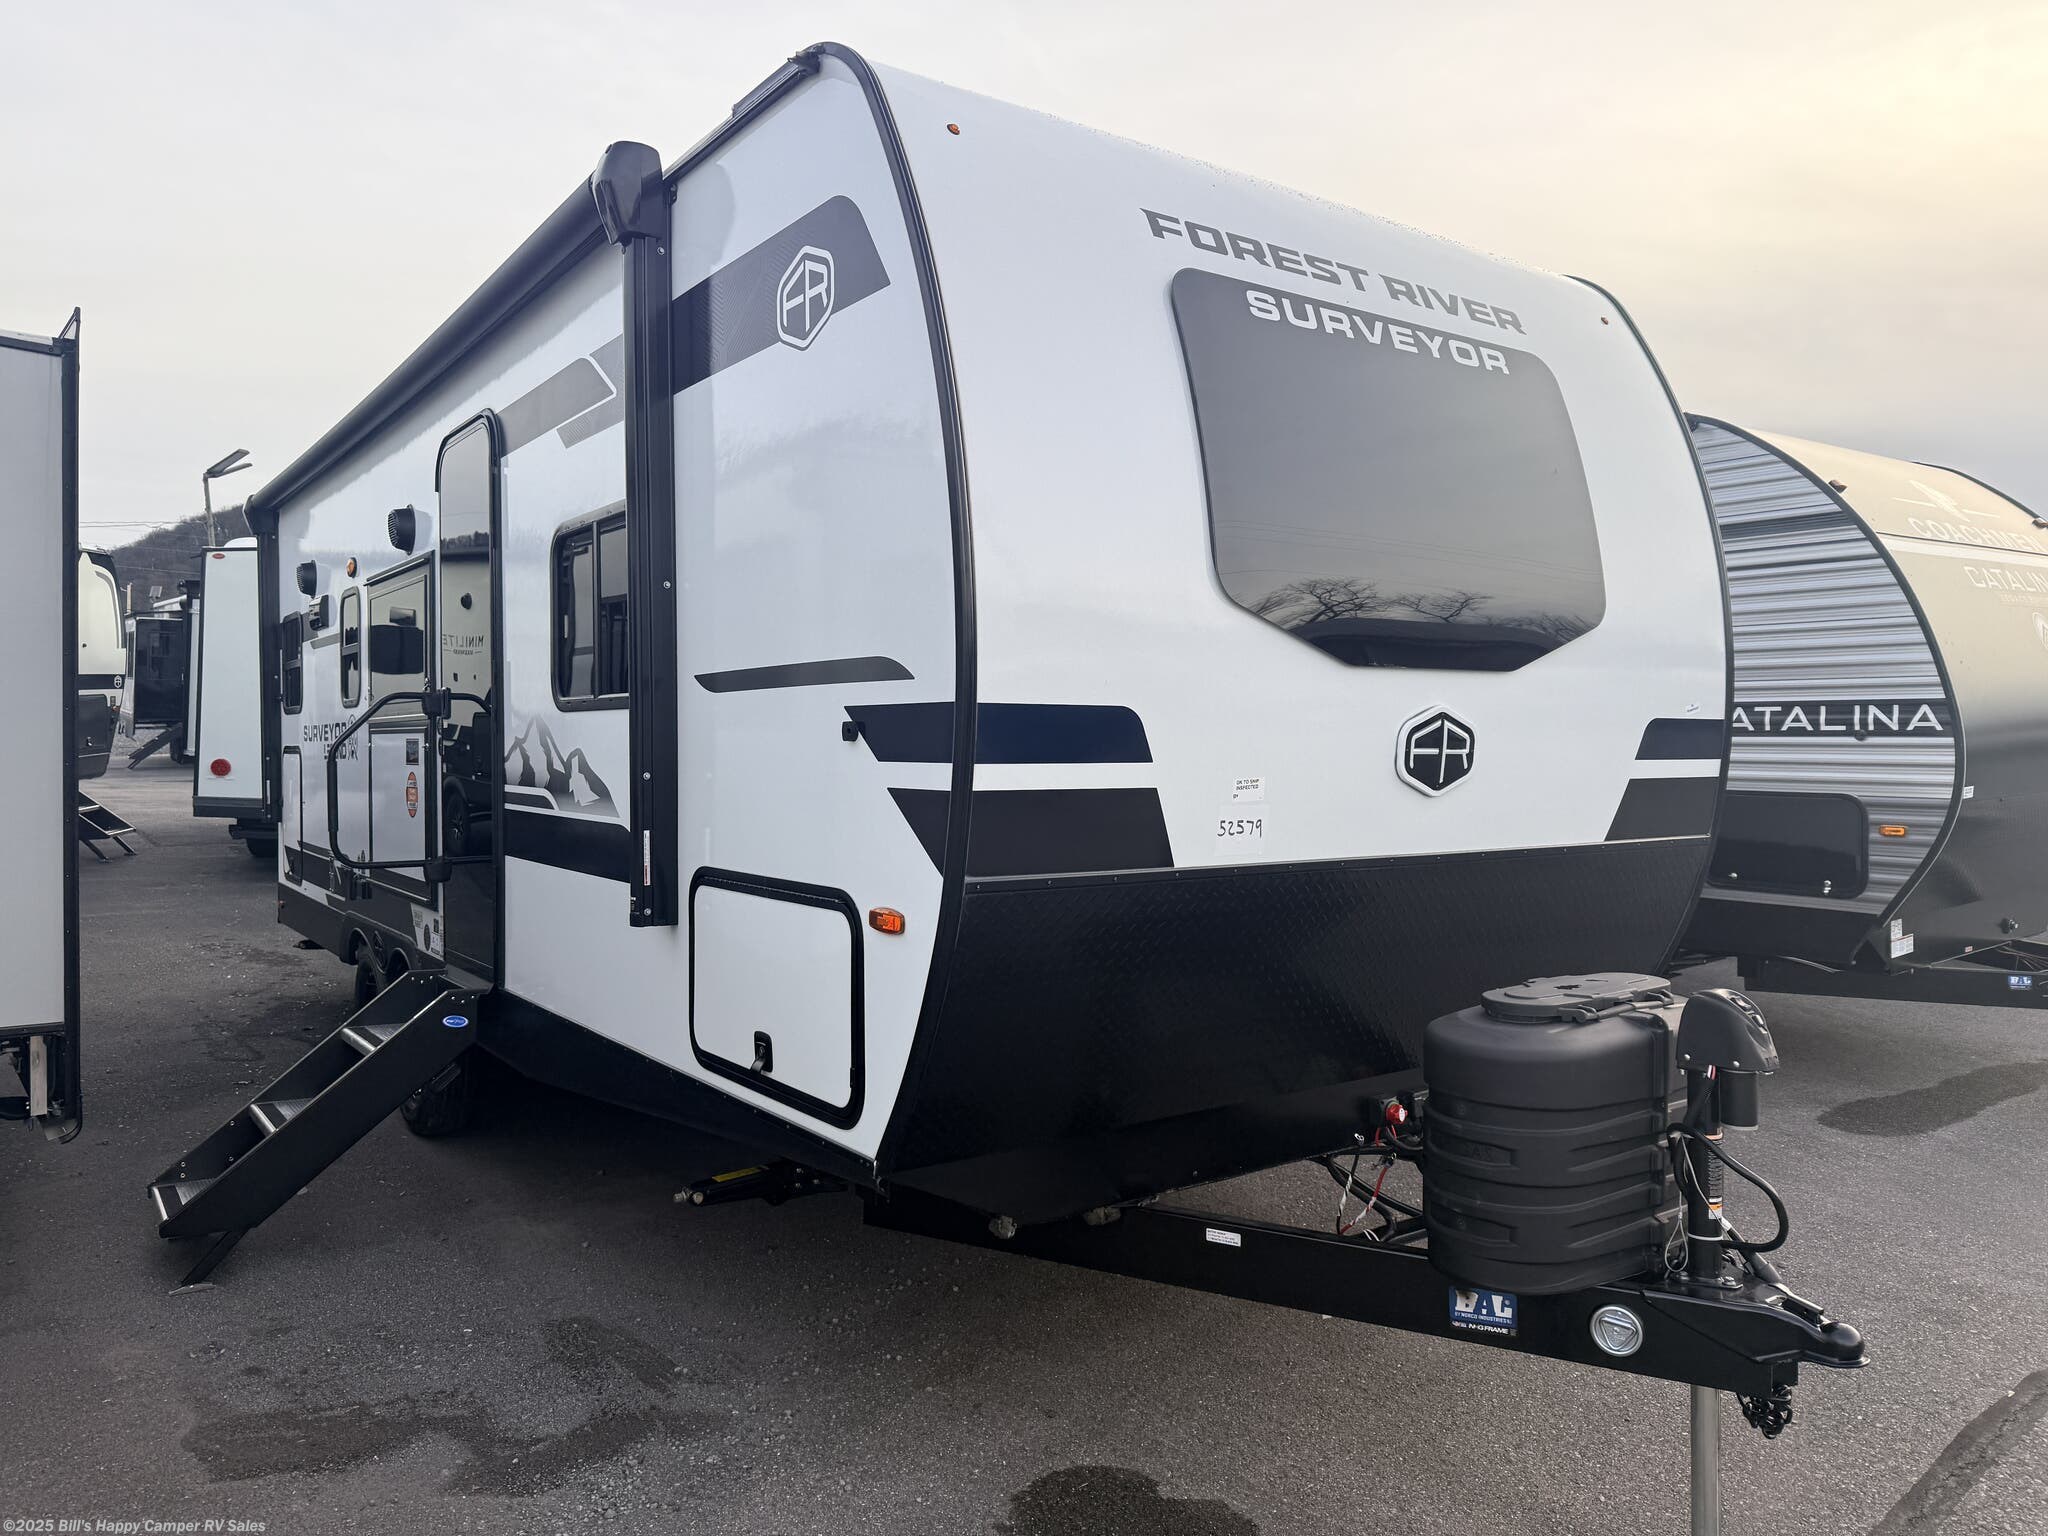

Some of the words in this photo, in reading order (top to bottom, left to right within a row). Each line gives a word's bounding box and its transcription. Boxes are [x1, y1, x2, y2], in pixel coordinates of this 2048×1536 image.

[1139, 207, 1369, 292] FOREST
[1378, 272, 1527, 335] RIVER
[1246, 289, 1510, 375] SURVEYOR
[1907, 517, 2047, 552] COACHMEN
[1964, 566, 2048, 593] CATALIN
[1732, 704, 1944, 731] ATALINA
[1217, 819, 1262, 838] 52579
[1454, 1289, 1513, 1319] BAL
